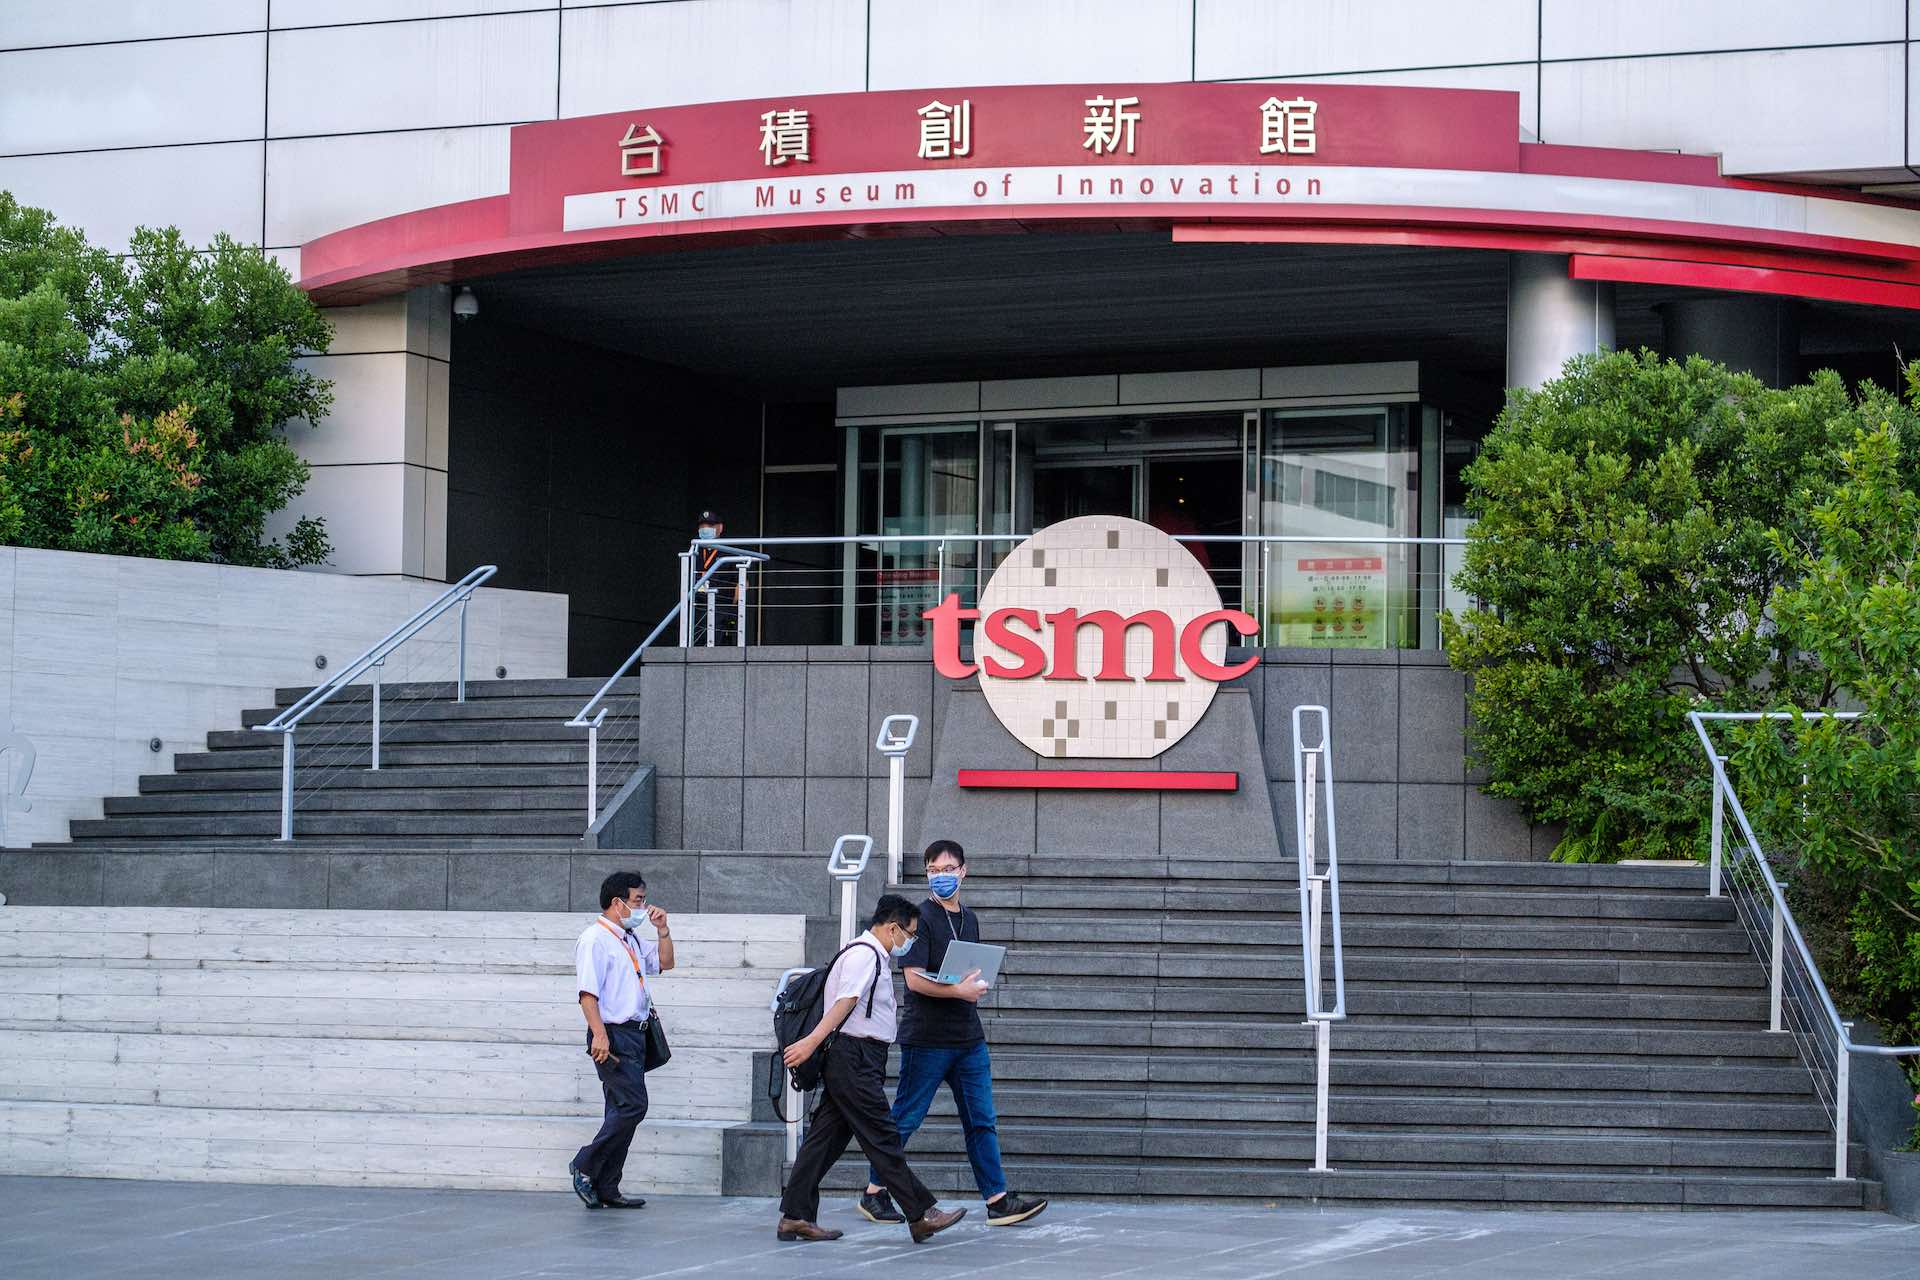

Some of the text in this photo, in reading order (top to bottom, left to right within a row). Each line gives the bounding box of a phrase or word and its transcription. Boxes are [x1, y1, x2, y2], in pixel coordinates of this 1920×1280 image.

[619, 95, 1318, 176] 台積創新館
[616, 173, 1321, 218] TSMC Museum of Innovation
[922, 592, 1261, 682] tsmc
